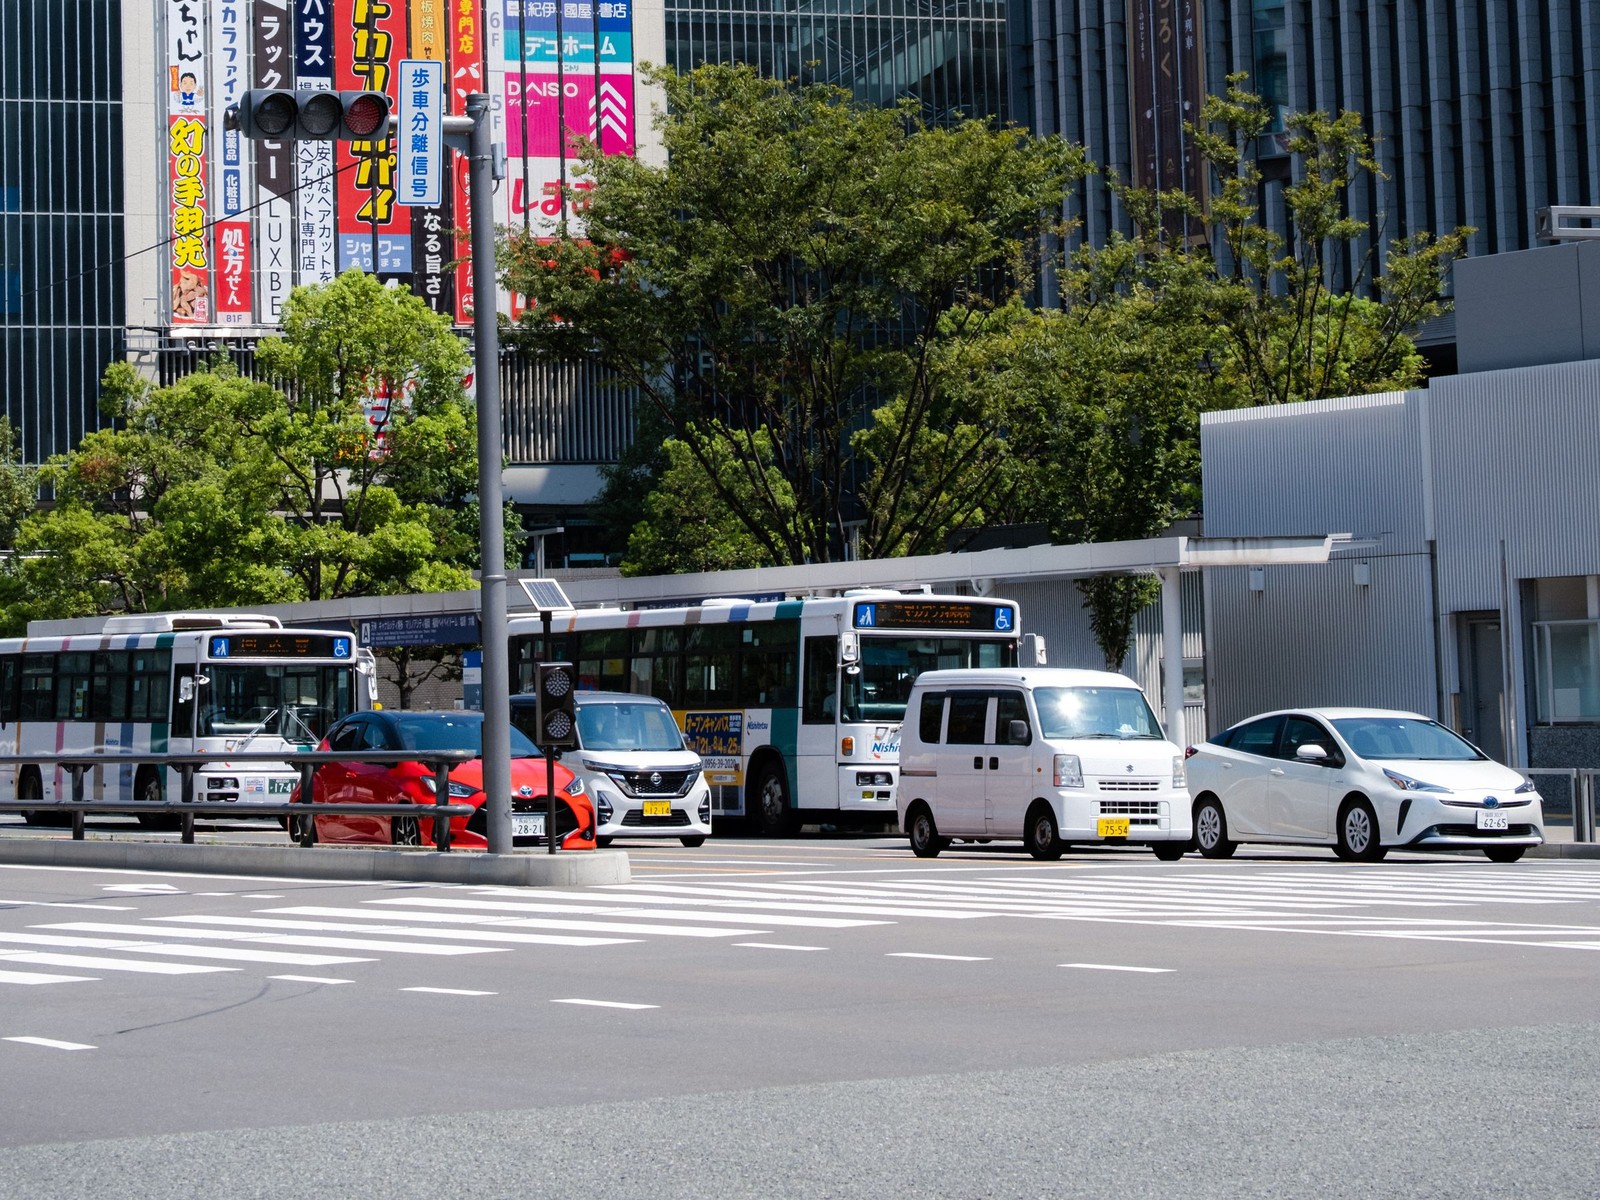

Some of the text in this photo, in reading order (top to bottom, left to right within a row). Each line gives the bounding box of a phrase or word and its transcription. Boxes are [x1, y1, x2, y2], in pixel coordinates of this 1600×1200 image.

[527, 1, 628, 19] 紀伊國屋書店
[507, 80, 579, 98] DAISO
[508, 99, 541, 107] ダイソー
[411, 67, 430, 199] 歩車分離信号
[169, 117, 208, 268] 幻の手羽先
[226, 174, 238, 210] 化粧品
[346, 239, 405, 256] シャワー
[351, 257, 401, 268] あります
[423, 205, 442, 311] なる旨さ!
[221, 228, 245, 306] 処方せん
[226, 314, 243, 323] B1F
[518, 824, 542, 835] 28-21
[1105, 825, 1128, 835] 75-54
[1484, 818, 1506, 828] 62-65
